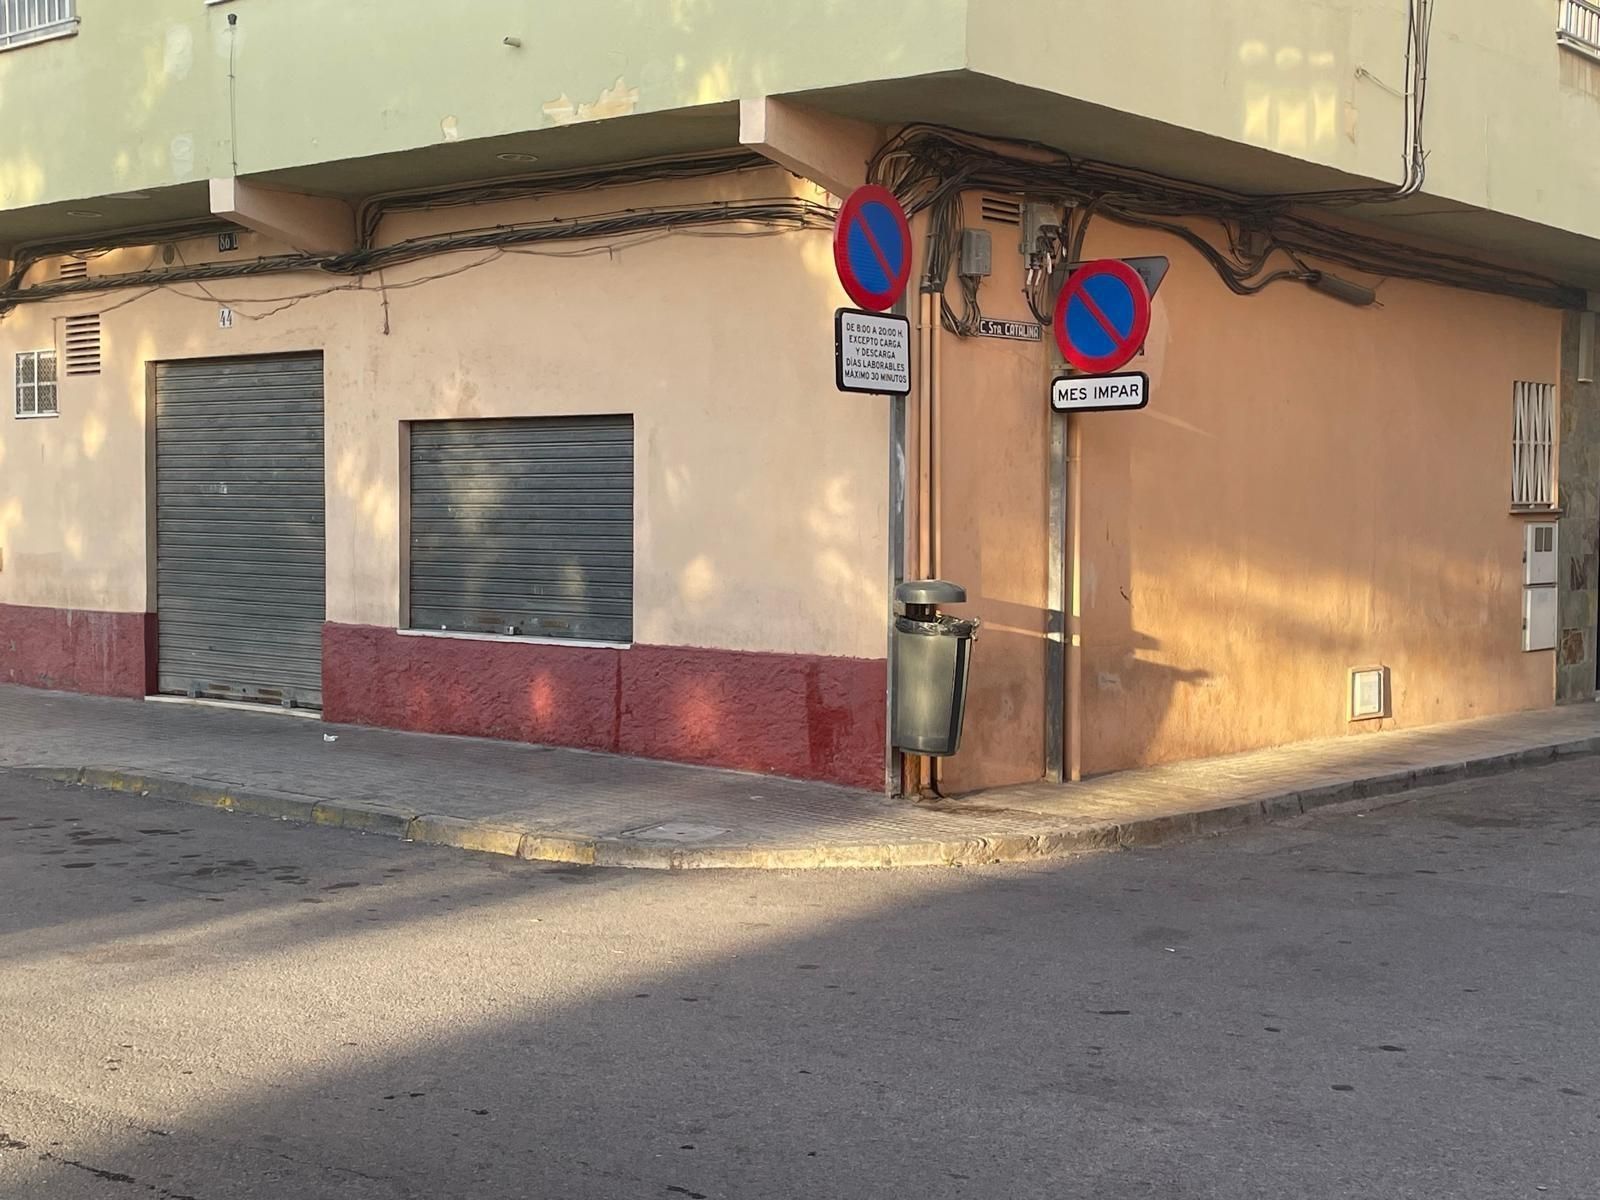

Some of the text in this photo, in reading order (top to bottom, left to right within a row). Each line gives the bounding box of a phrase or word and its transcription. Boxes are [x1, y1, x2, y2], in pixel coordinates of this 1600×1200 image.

[220, 310, 232, 326] 44
[846, 323, 855, 332] DE
[1005, 323, 1039, 338] CATALINA
[849, 335, 902, 348] EXCEPTO CARGA
[856, 347, 896, 359] Y DESCARGA
[863, 360, 905, 372] LABORABLES
[871, 372, 879, 381] 30
[881, 373, 907, 383] MINUTOS
[1058, 384, 1139, 402] MES IMPAR
